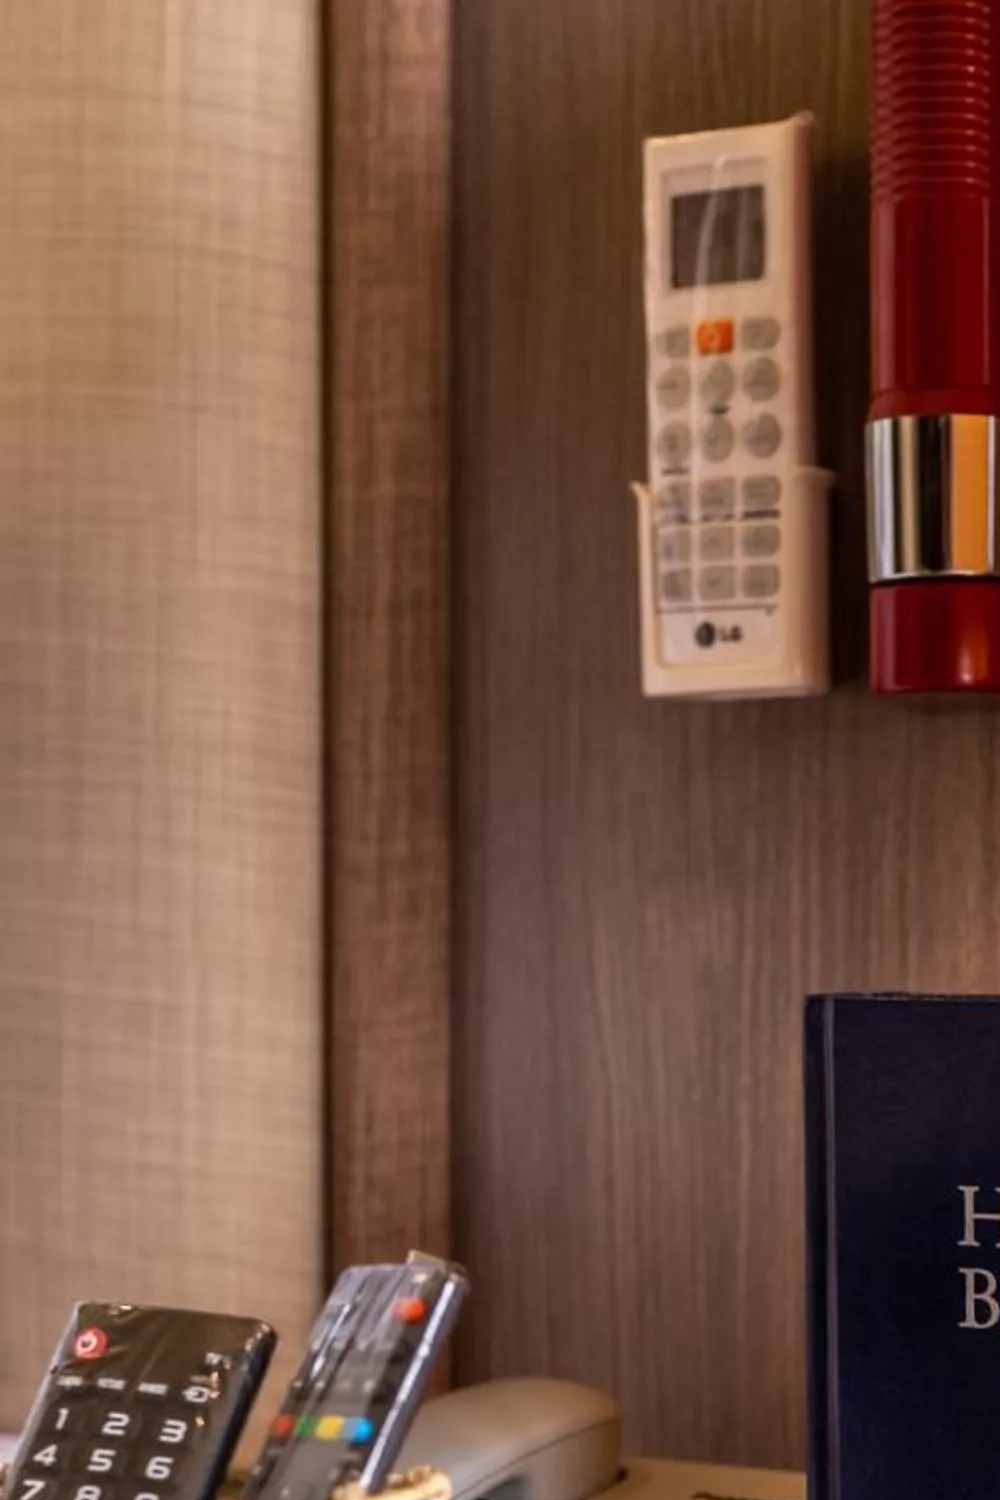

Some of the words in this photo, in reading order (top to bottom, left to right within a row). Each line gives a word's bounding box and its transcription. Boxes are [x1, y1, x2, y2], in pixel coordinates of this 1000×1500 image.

[56, 1408, 69, 1430] 1
[102, 1412, 130, 1435] 2
[159, 1419, 187, 1443] 3
[33, 1444, 57, 1466] 4
[87, 1449, 116, 1472] 5
[145, 1456, 174, 1479] 6
